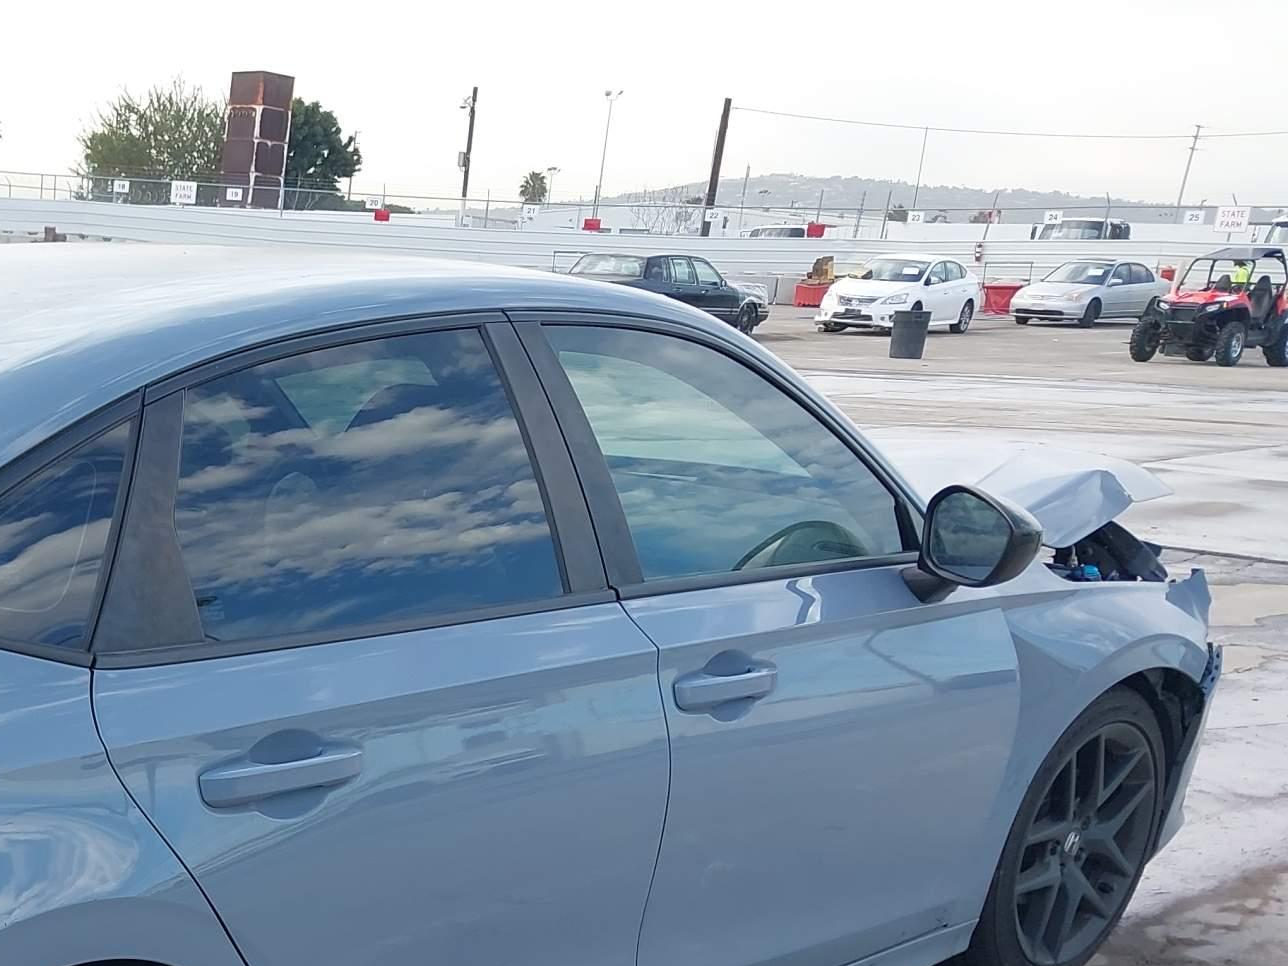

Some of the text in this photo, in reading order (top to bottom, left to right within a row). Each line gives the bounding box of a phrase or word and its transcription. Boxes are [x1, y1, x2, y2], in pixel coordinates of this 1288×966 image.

[911, 214, 921, 222] 23
[1048, 213, 1058, 221] 24
[1188, 213, 1200, 221] 25
[1221, 210, 1247, 218] STATE
[1219, 220, 1242, 228] FARM
